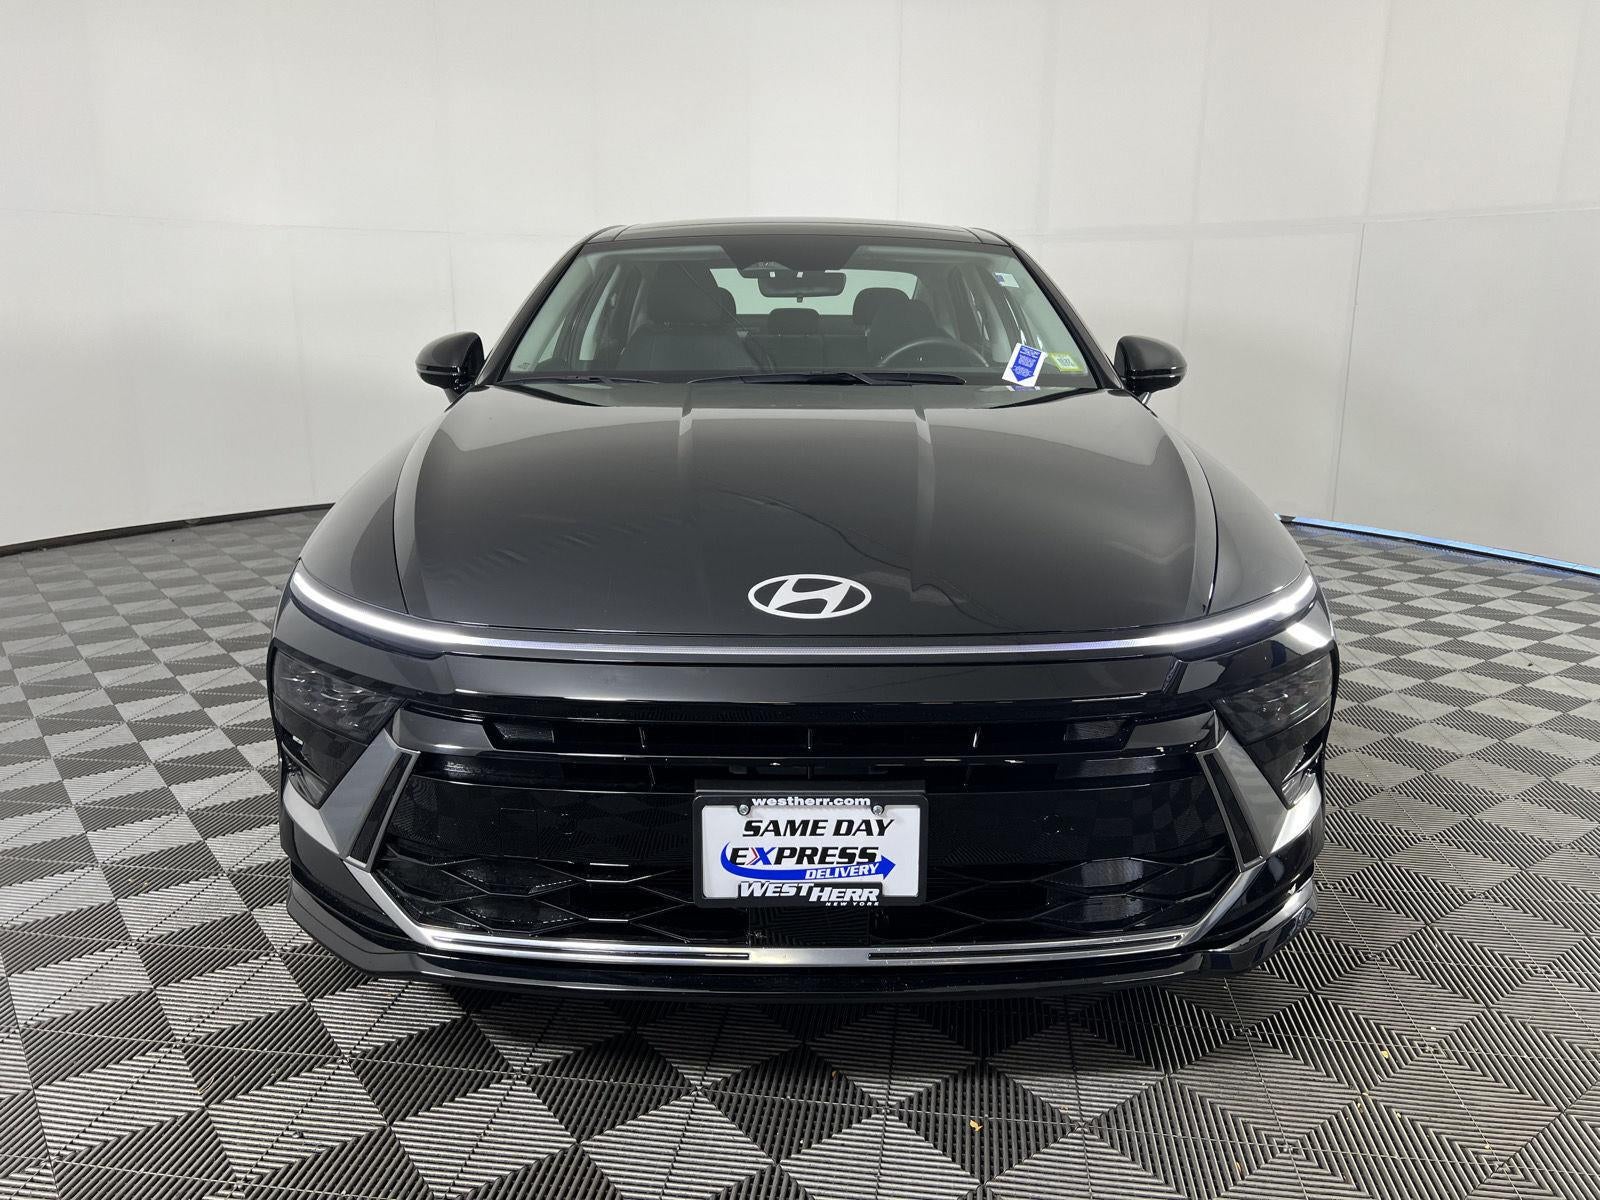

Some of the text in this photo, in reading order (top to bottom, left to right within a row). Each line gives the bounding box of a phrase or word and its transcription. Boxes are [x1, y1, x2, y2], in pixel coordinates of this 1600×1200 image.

[752, 796, 871, 806] westherr.com
[742, 819, 895, 837] SAME DAY
[729, 847, 879, 866] EXPRESS
[804, 863, 880, 880] DELIVERY
